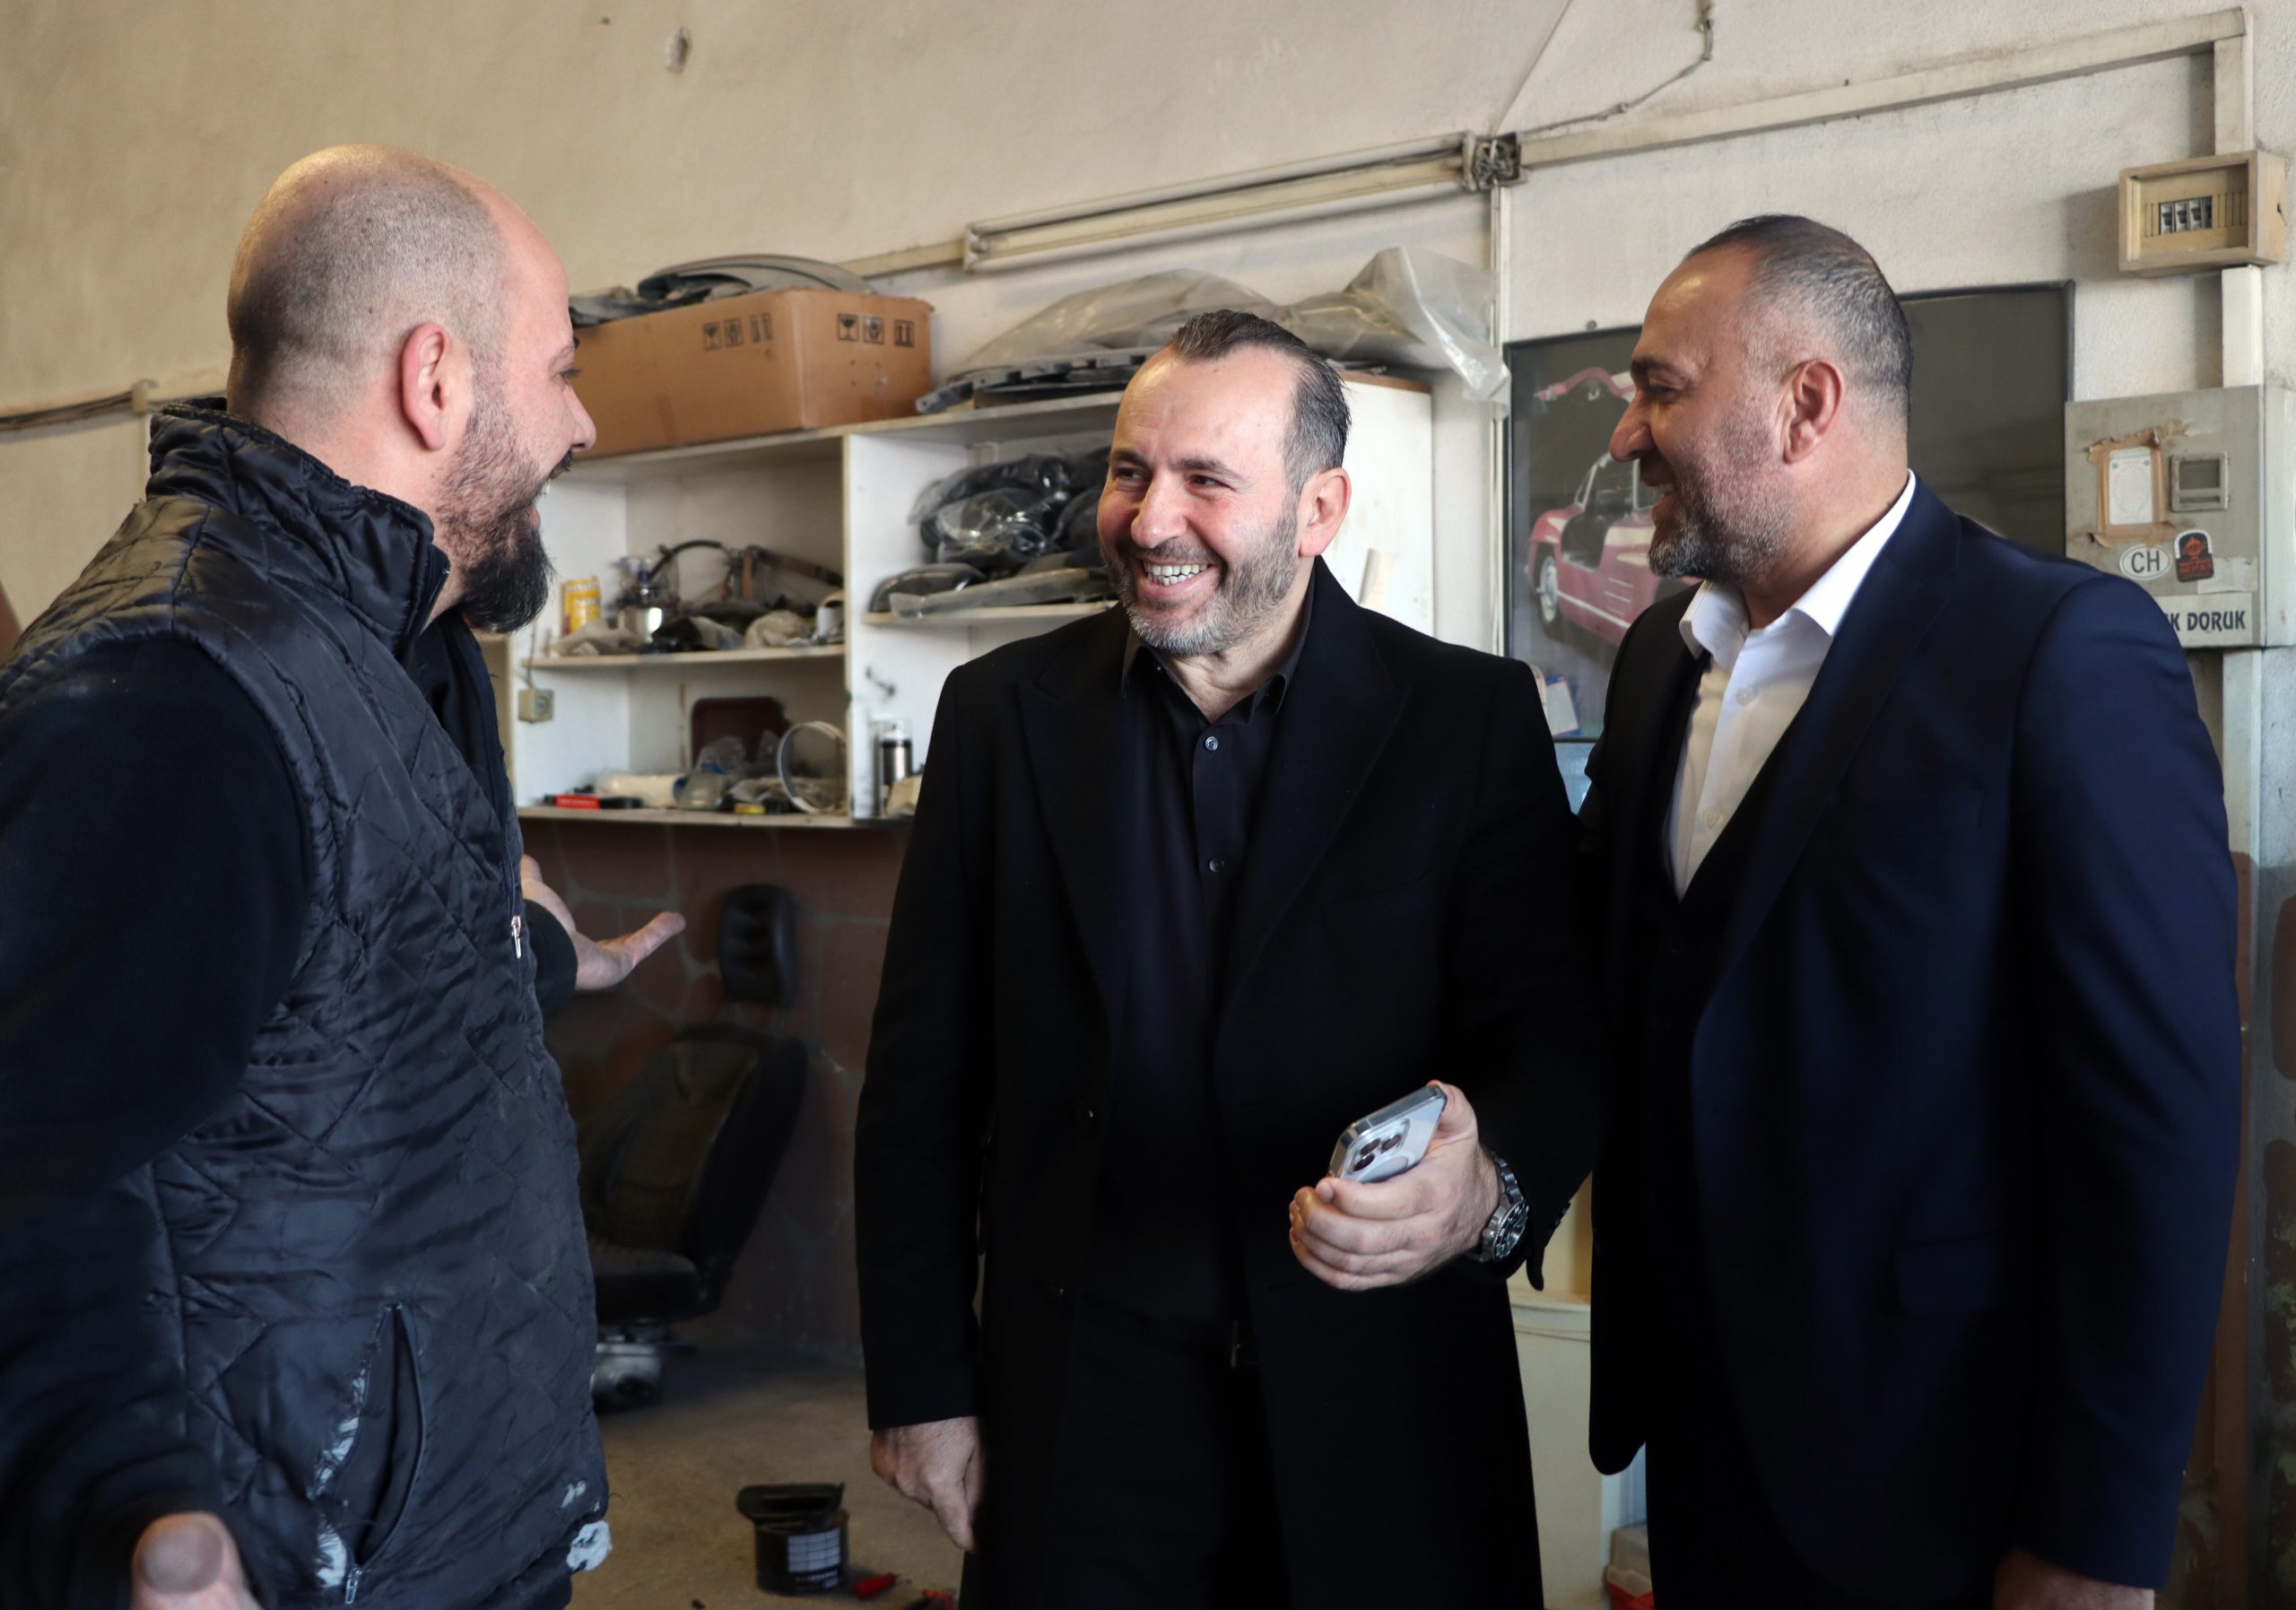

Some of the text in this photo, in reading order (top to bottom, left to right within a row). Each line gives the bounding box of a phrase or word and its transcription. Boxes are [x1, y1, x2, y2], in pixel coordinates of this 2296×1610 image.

[2131, 551, 2160, 573] CH
[2165, 611, 2246, 631] K DORUK
